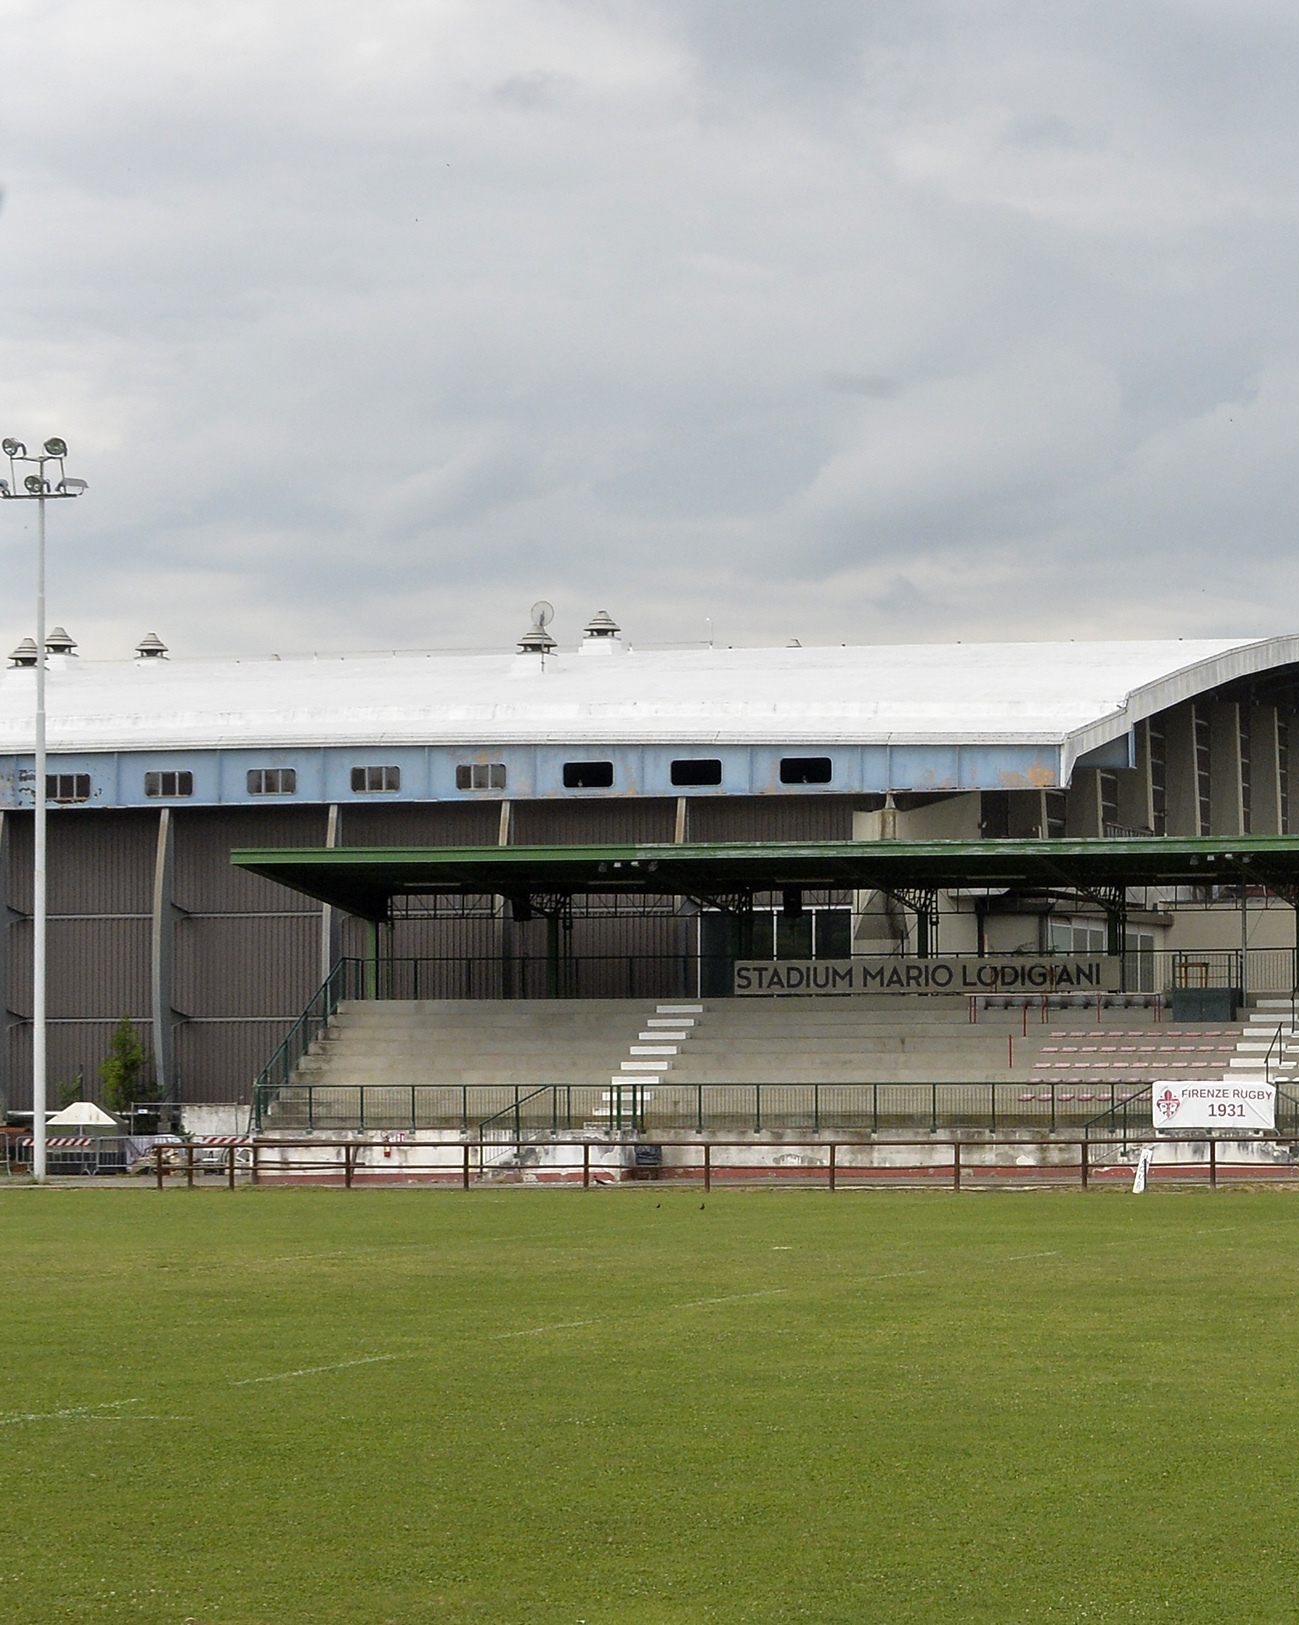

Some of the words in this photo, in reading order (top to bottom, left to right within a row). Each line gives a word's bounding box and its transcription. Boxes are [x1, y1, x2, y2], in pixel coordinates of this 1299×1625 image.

[736, 966, 854, 989] STADIUM
[863, 964, 953, 988] MARIO
[962, 963, 1100, 987] LODIGIANI
[1181, 1088, 1229, 1099] FIRENZE
[1232, 1088, 1273, 1100] RUGBY
[1208, 1103, 1246, 1117] 1931
